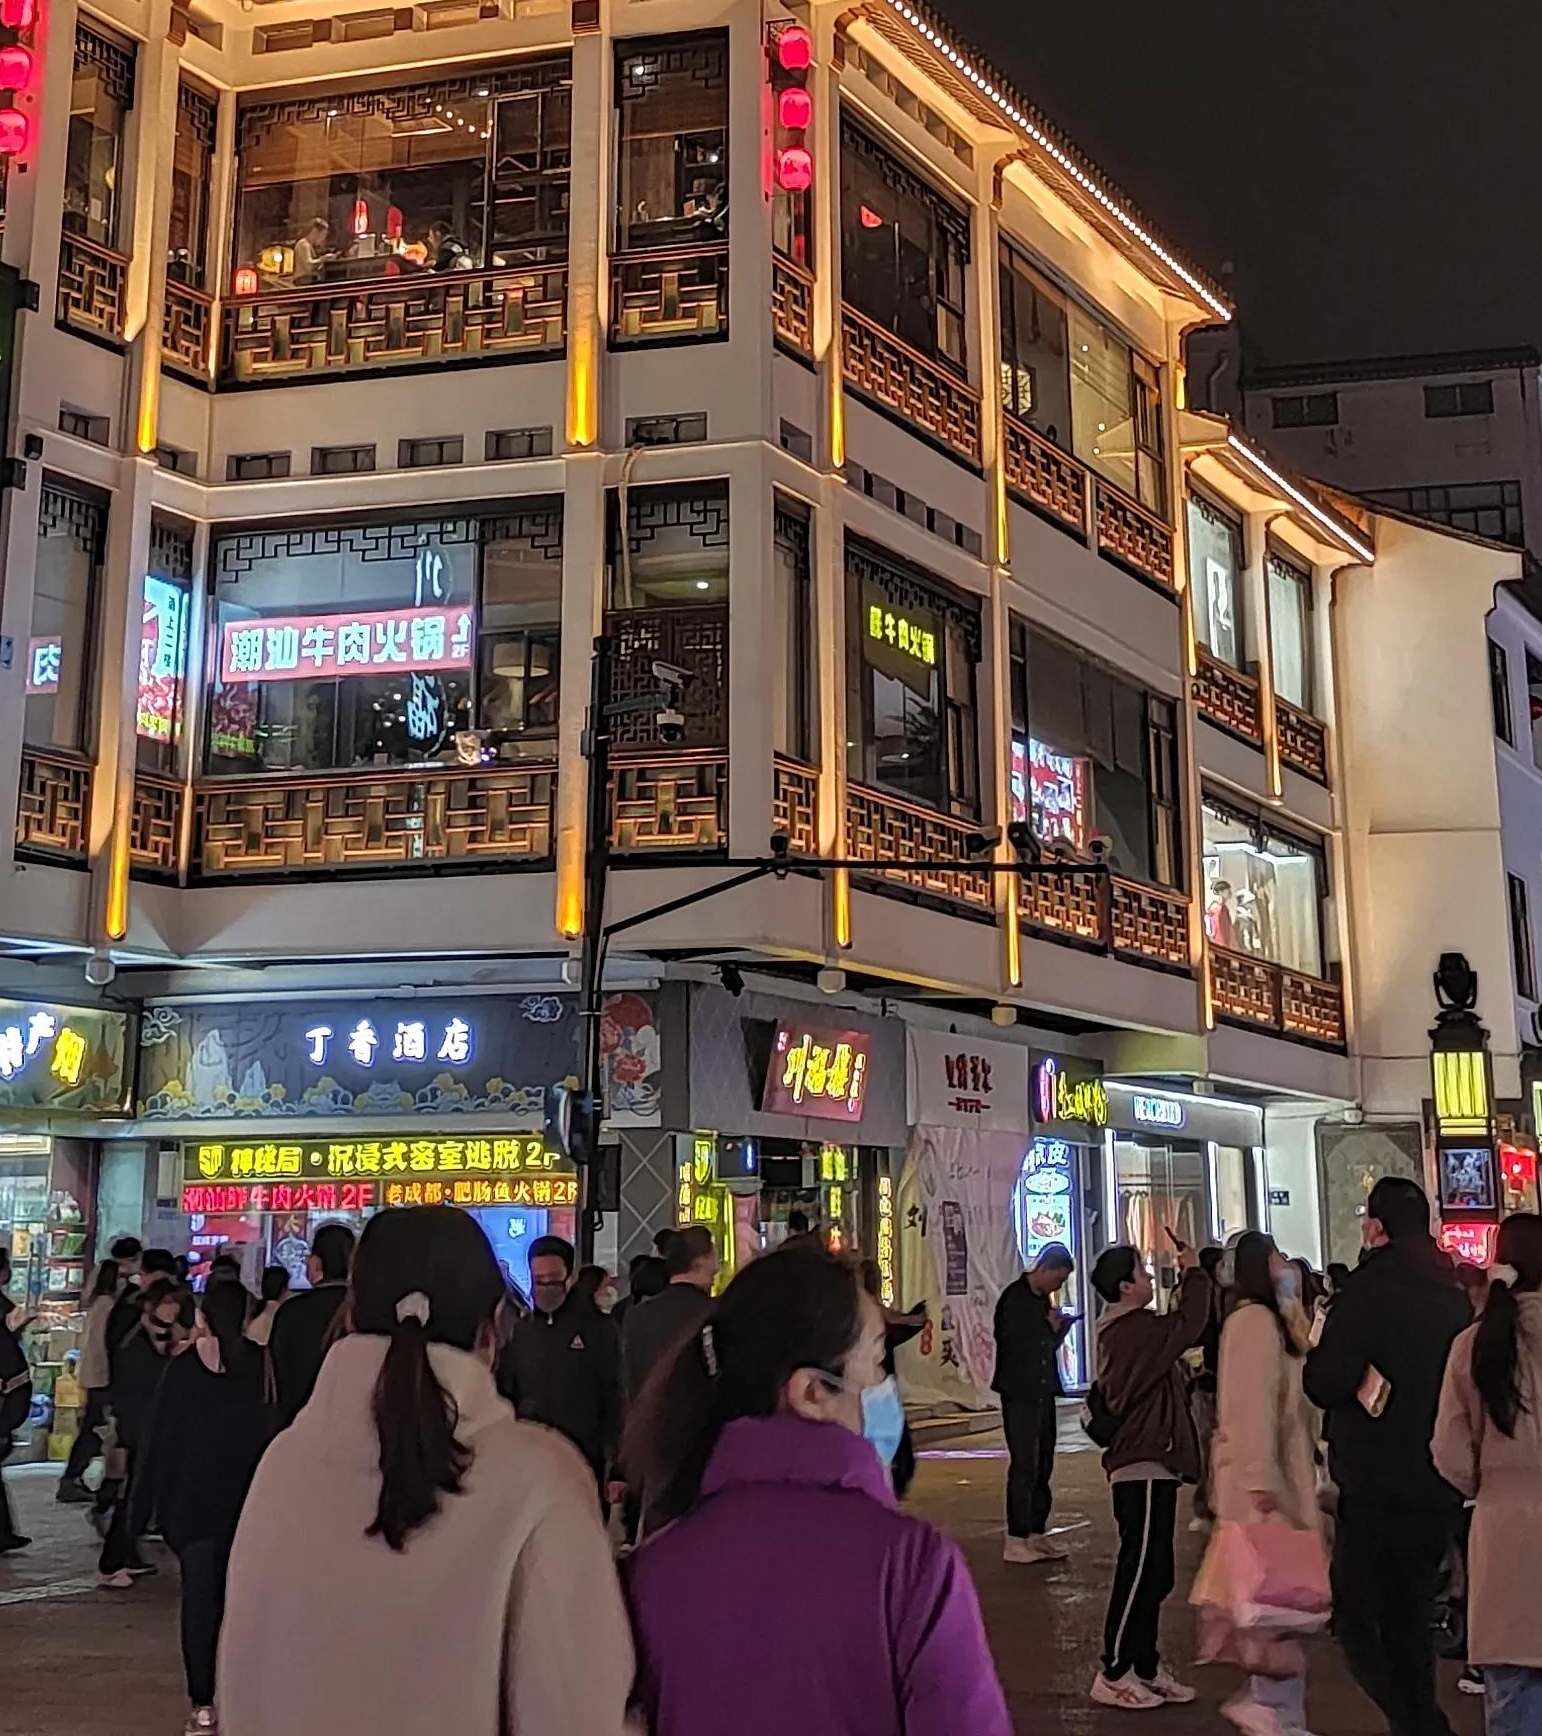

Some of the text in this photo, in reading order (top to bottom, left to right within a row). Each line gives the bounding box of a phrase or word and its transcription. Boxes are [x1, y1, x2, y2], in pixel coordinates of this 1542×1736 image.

[229, 615, 446, 673] 潮汕牛肉火锅
[304, 1018, 473, 1065] 丁香酒店
